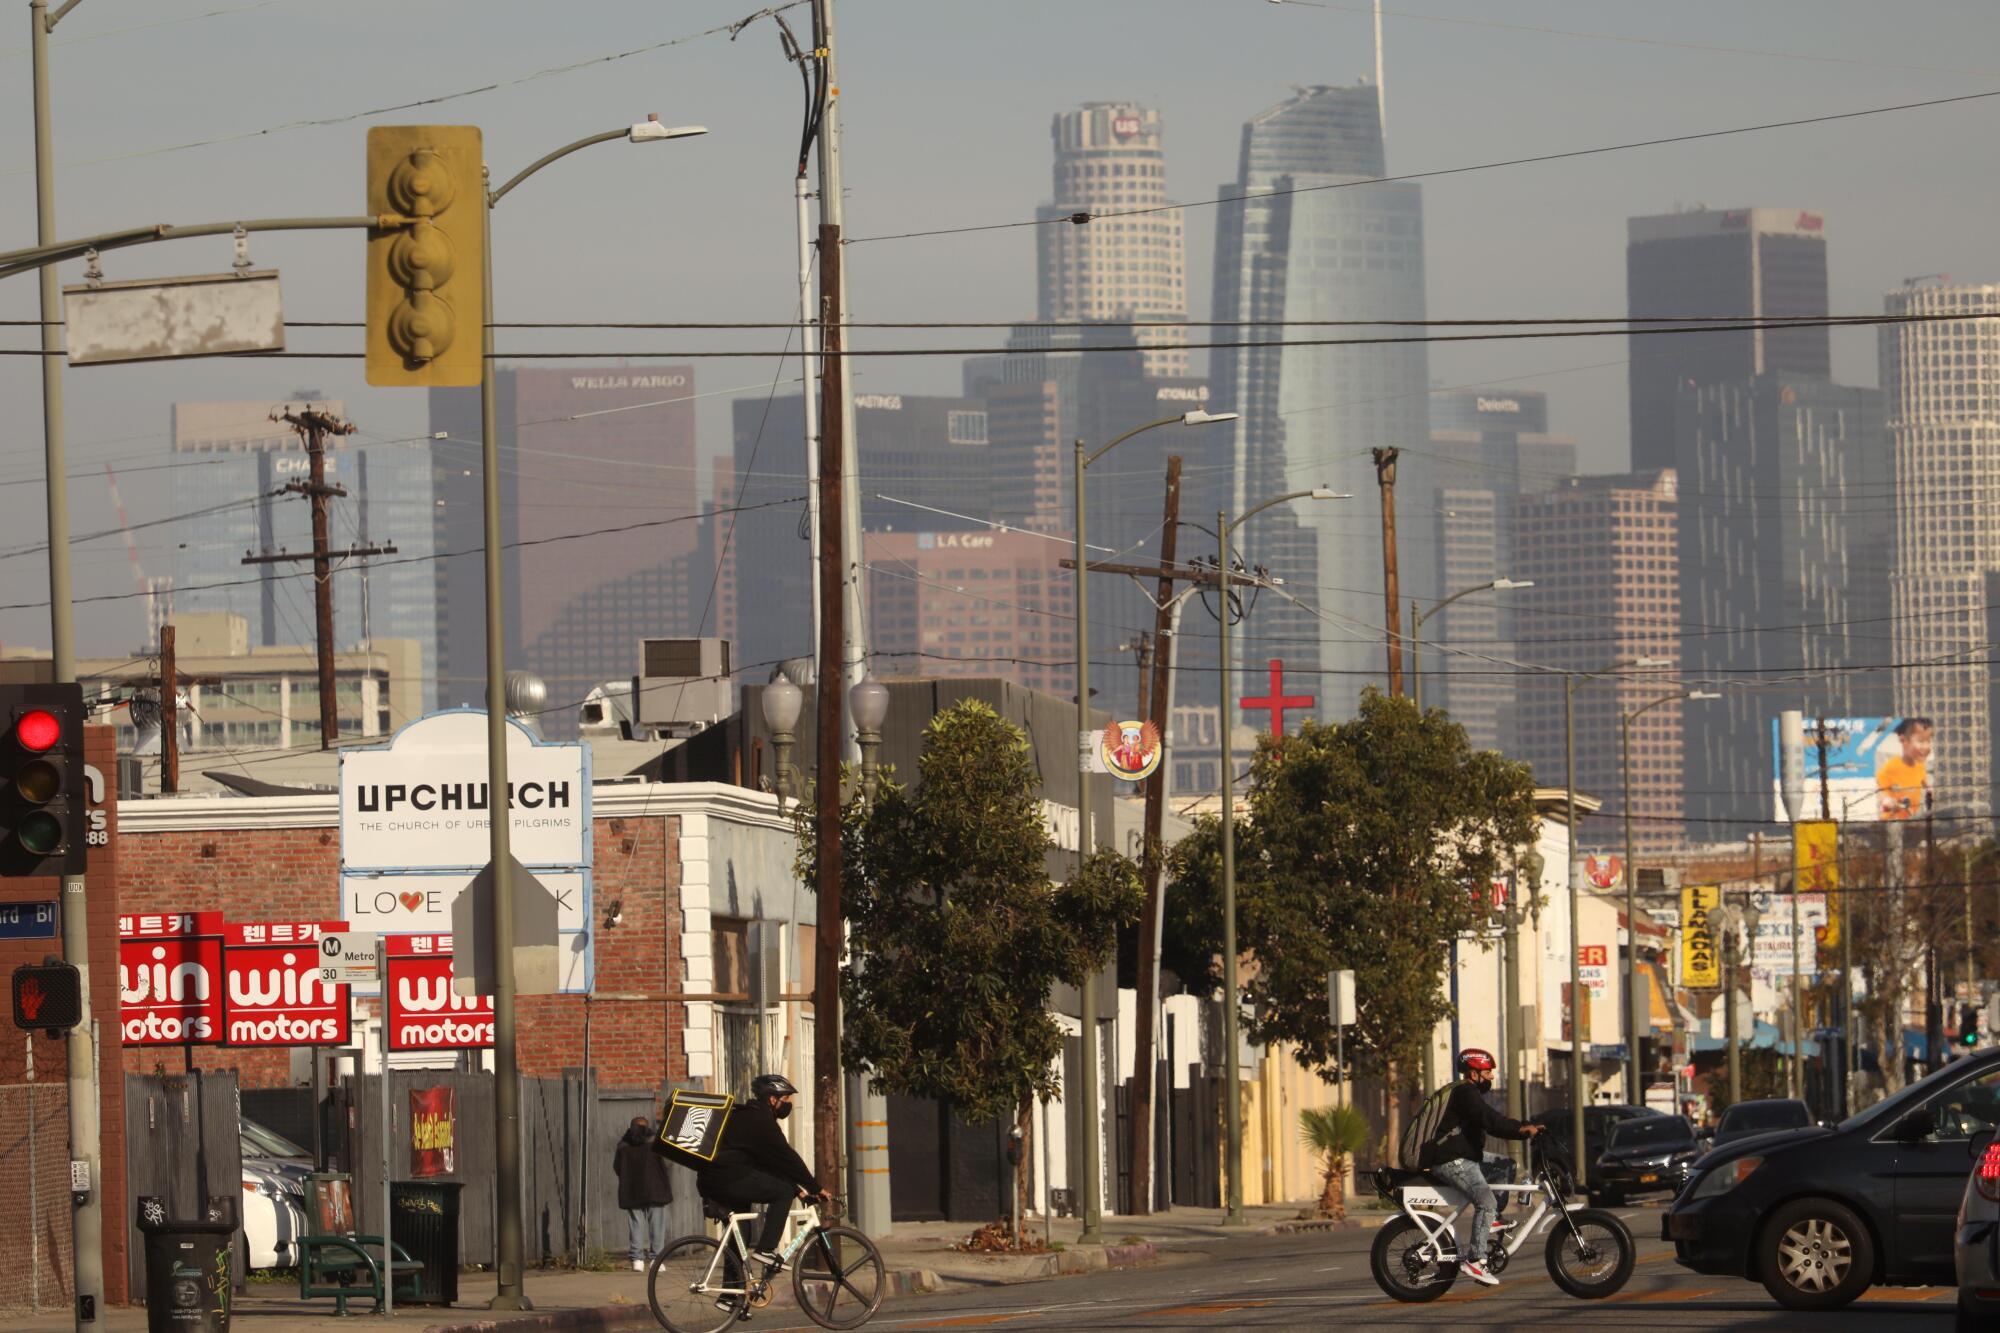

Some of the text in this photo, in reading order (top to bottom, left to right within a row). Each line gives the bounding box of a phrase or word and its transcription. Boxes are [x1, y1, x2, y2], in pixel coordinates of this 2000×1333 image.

[571, 375, 685, 389] WELLS FARGO
[276, 458, 337, 473] CHAE
[937, 533, 994, 548] LA Care
[360, 818, 571, 831] THE CHURCH OF URB PILGRIMS
[243, 924, 321, 943] 렌트카
[411, 936, 453, 953] 렌트
[345, 952, 375, 961] Metro
[229, 953, 337, 1006] win
[322, 968, 337, 979] 30
[121, 1011, 212, 1041] otors
[231, 1013, 338, 1041] motors
